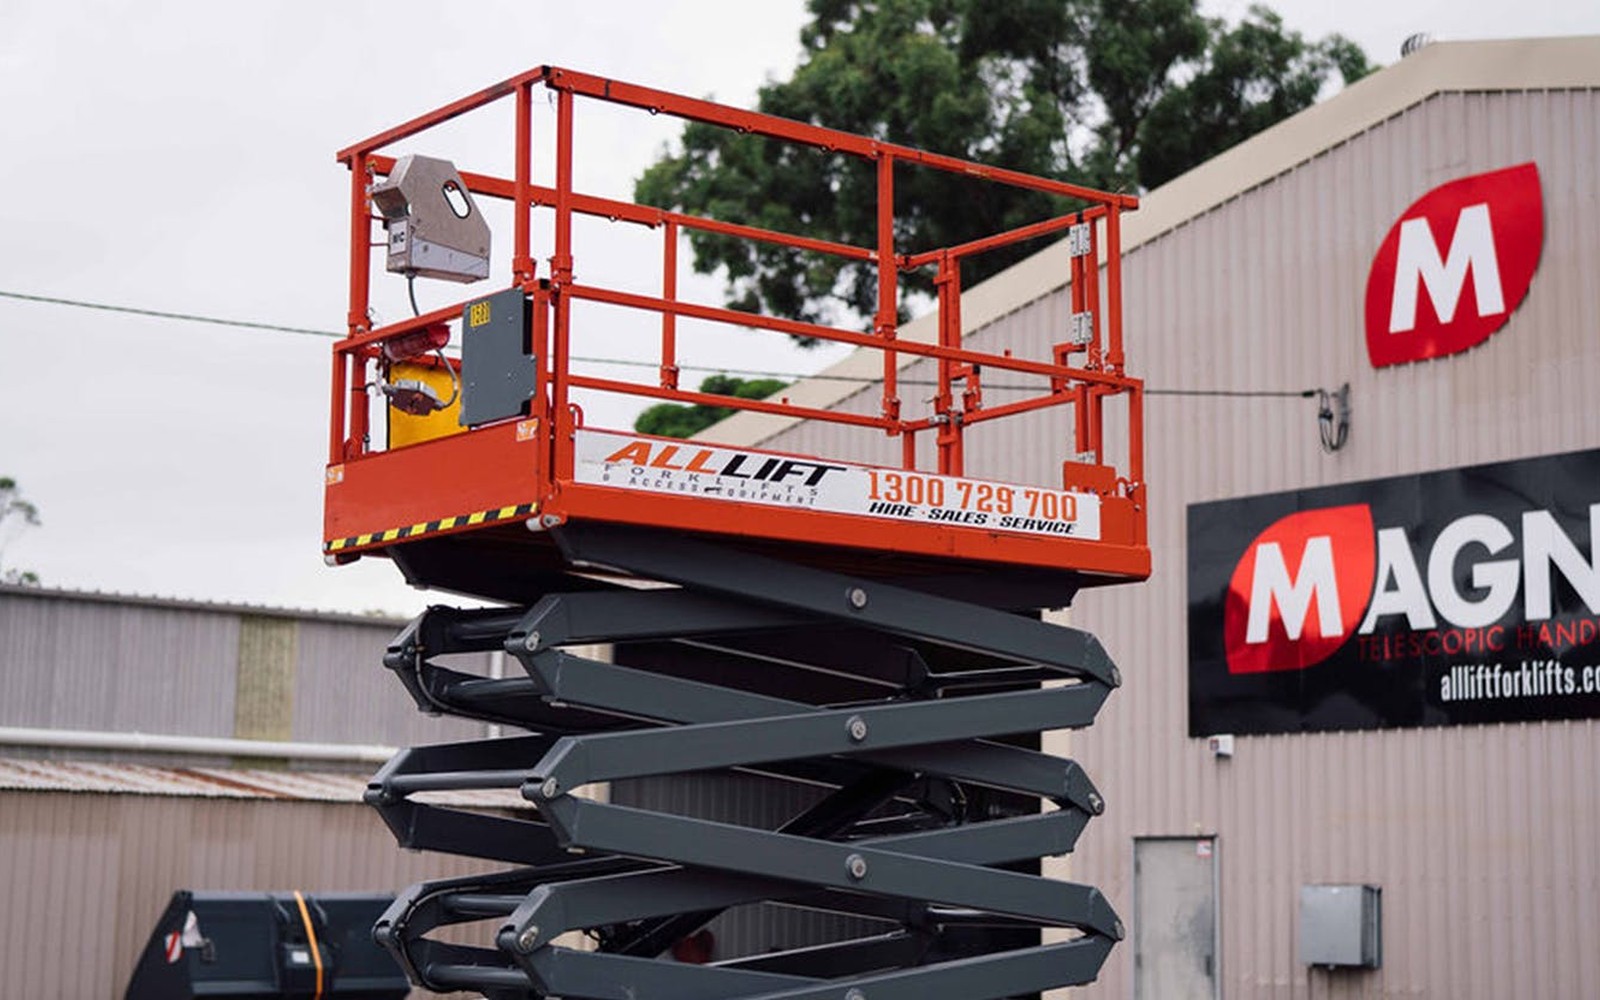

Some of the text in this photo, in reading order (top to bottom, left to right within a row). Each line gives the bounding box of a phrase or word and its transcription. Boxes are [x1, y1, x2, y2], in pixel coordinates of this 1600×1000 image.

[1389, 203, 1505, 334] M
[604, 463, 819, 496] FORKLIFTS
[868, 471, 1077, 522] 1300 729 700
[869, 502, 1077, 535] HIRE SALES SERVICE
[1358, 618, 1600, 662] TELESCOPIC HAND
